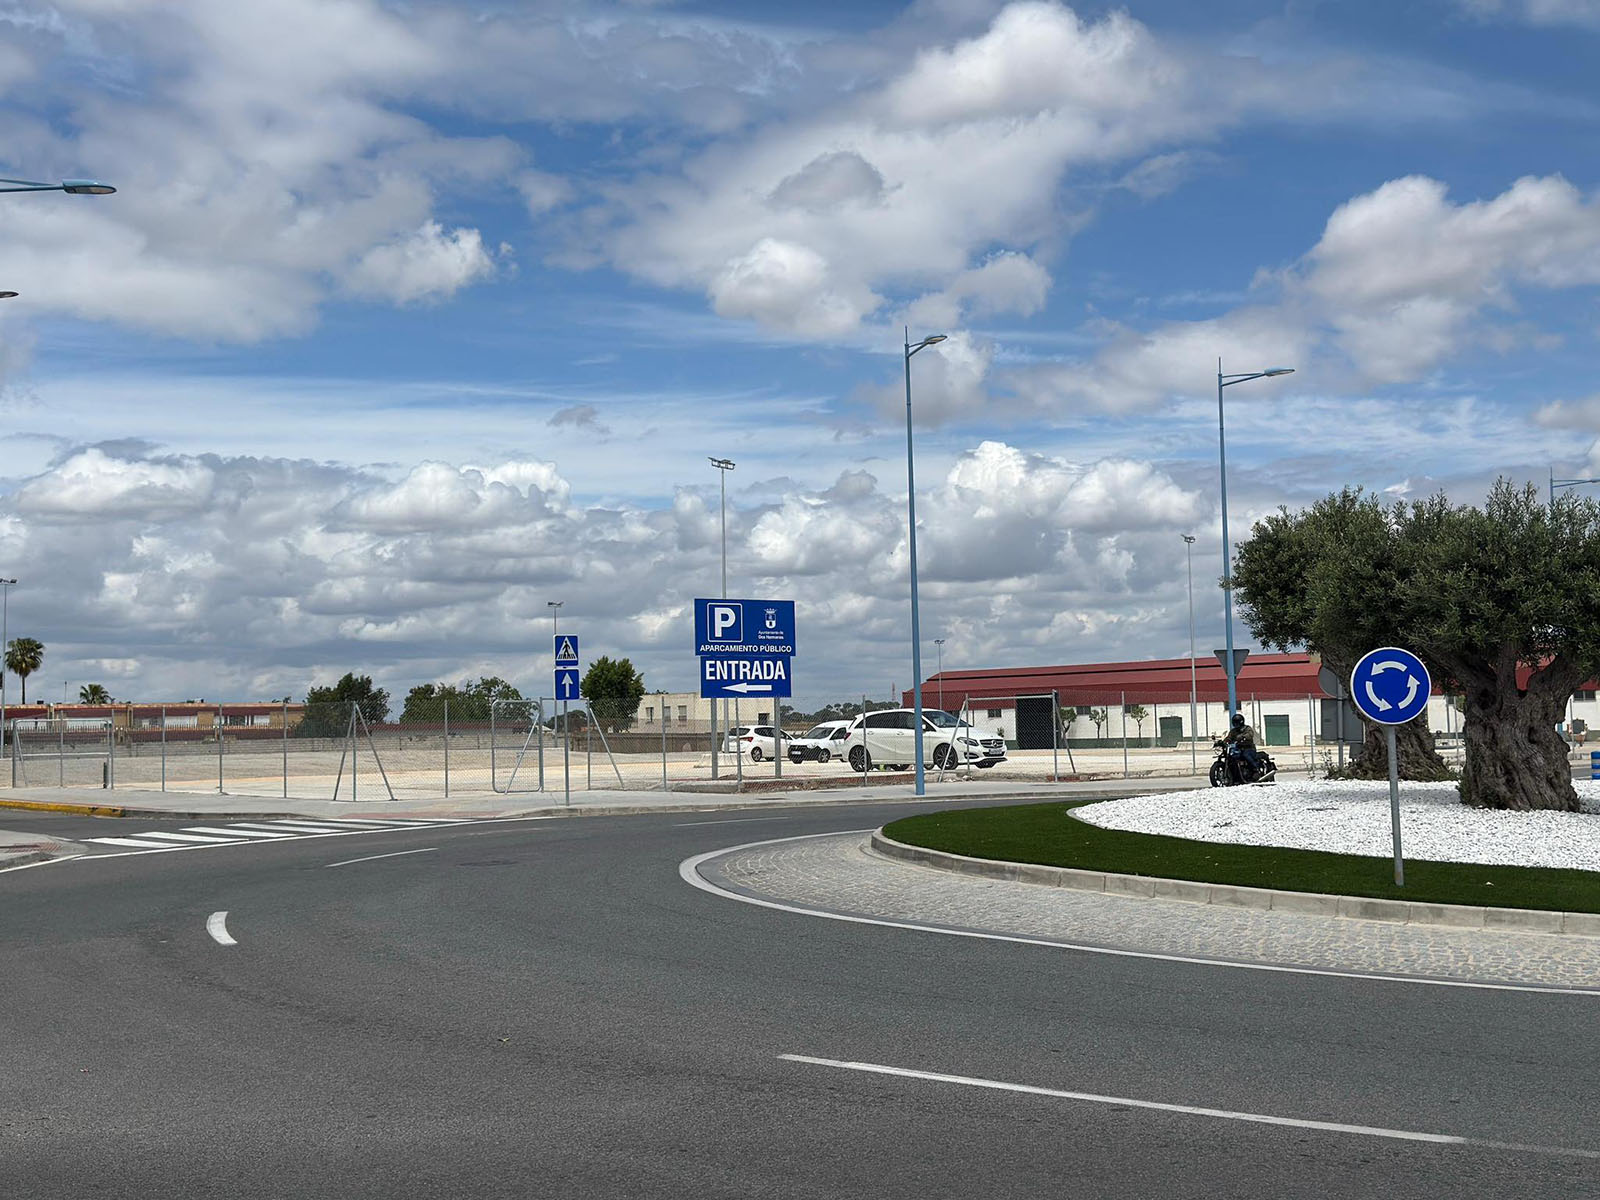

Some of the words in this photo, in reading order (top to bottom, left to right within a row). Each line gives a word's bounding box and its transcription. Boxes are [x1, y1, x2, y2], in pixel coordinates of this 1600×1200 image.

[714, 607, 736, 638] P
[700, 644, 758, 653] APARCAMIENTO
[760, 643, 792, 653] PÚBLICO
[705, 660, 786, 680] ENTRADA
